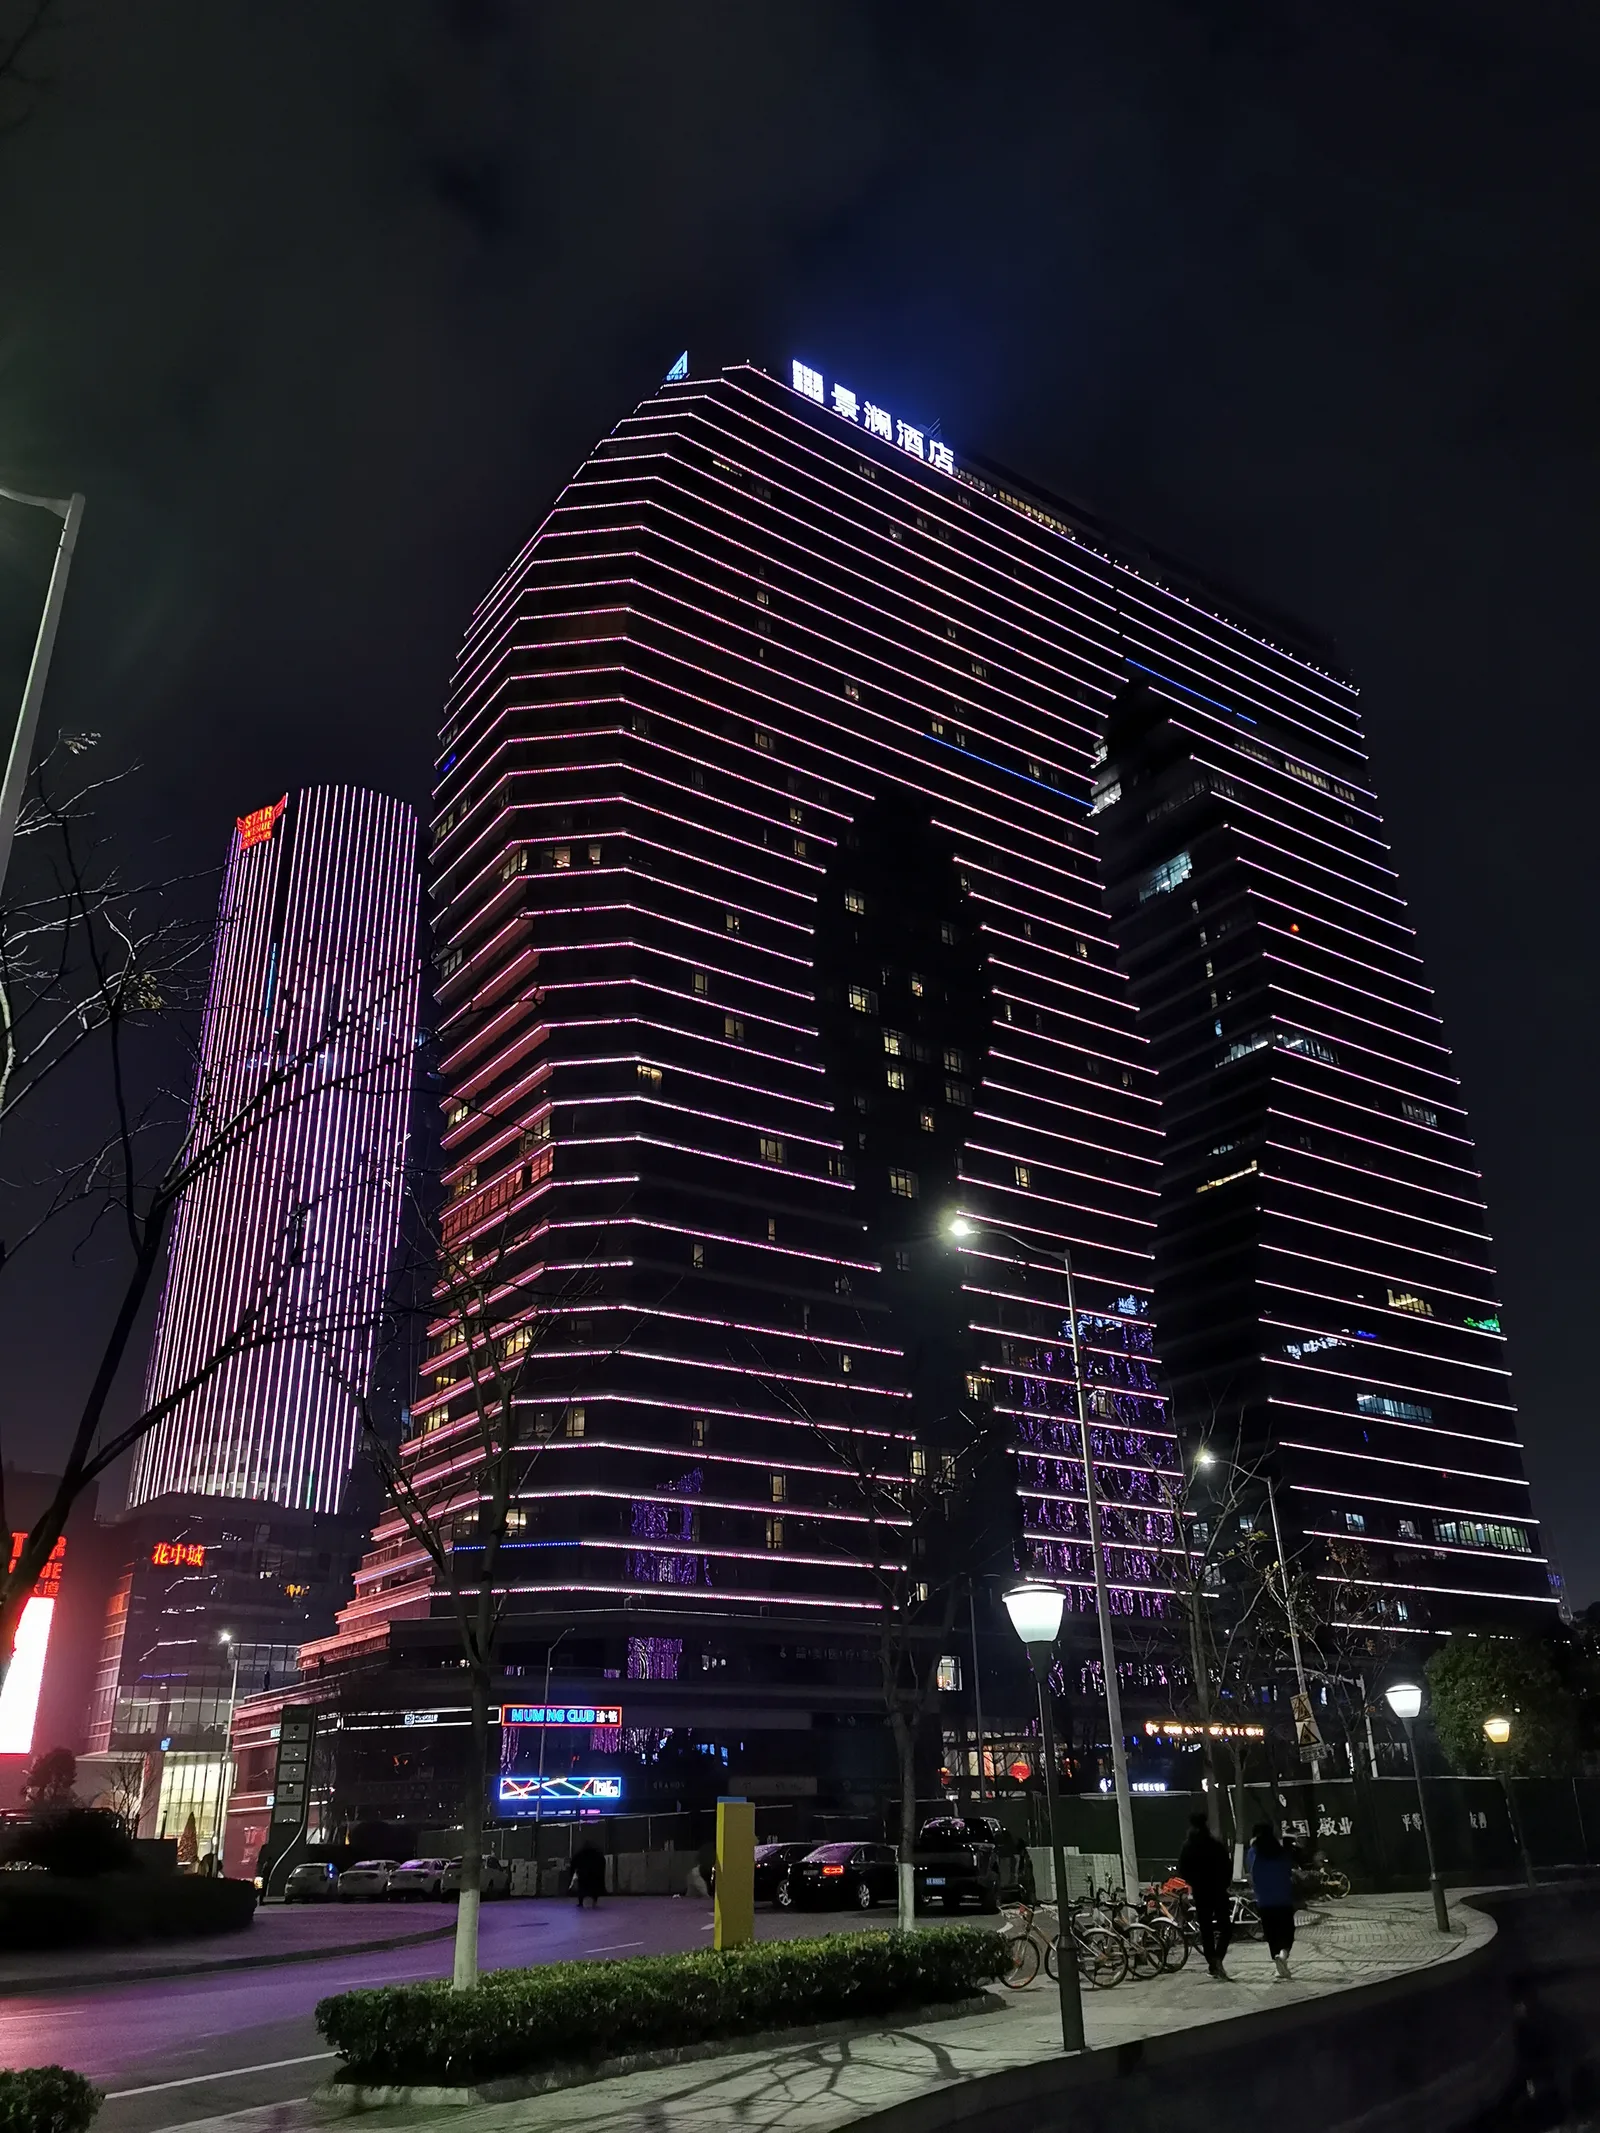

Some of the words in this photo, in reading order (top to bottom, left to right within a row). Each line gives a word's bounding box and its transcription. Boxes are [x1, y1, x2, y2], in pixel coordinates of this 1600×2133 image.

[830, 383, 954, 475] 景澜酒店
[244, 806, 274, 829] STAR
[152, 1542, 206, 1567] 花中城
[511, 1708, 566, 1723] MUMNG
[566, 1709, 595, 1723] CLUB
[1316, 1816, 1354, 1838] 敬业
